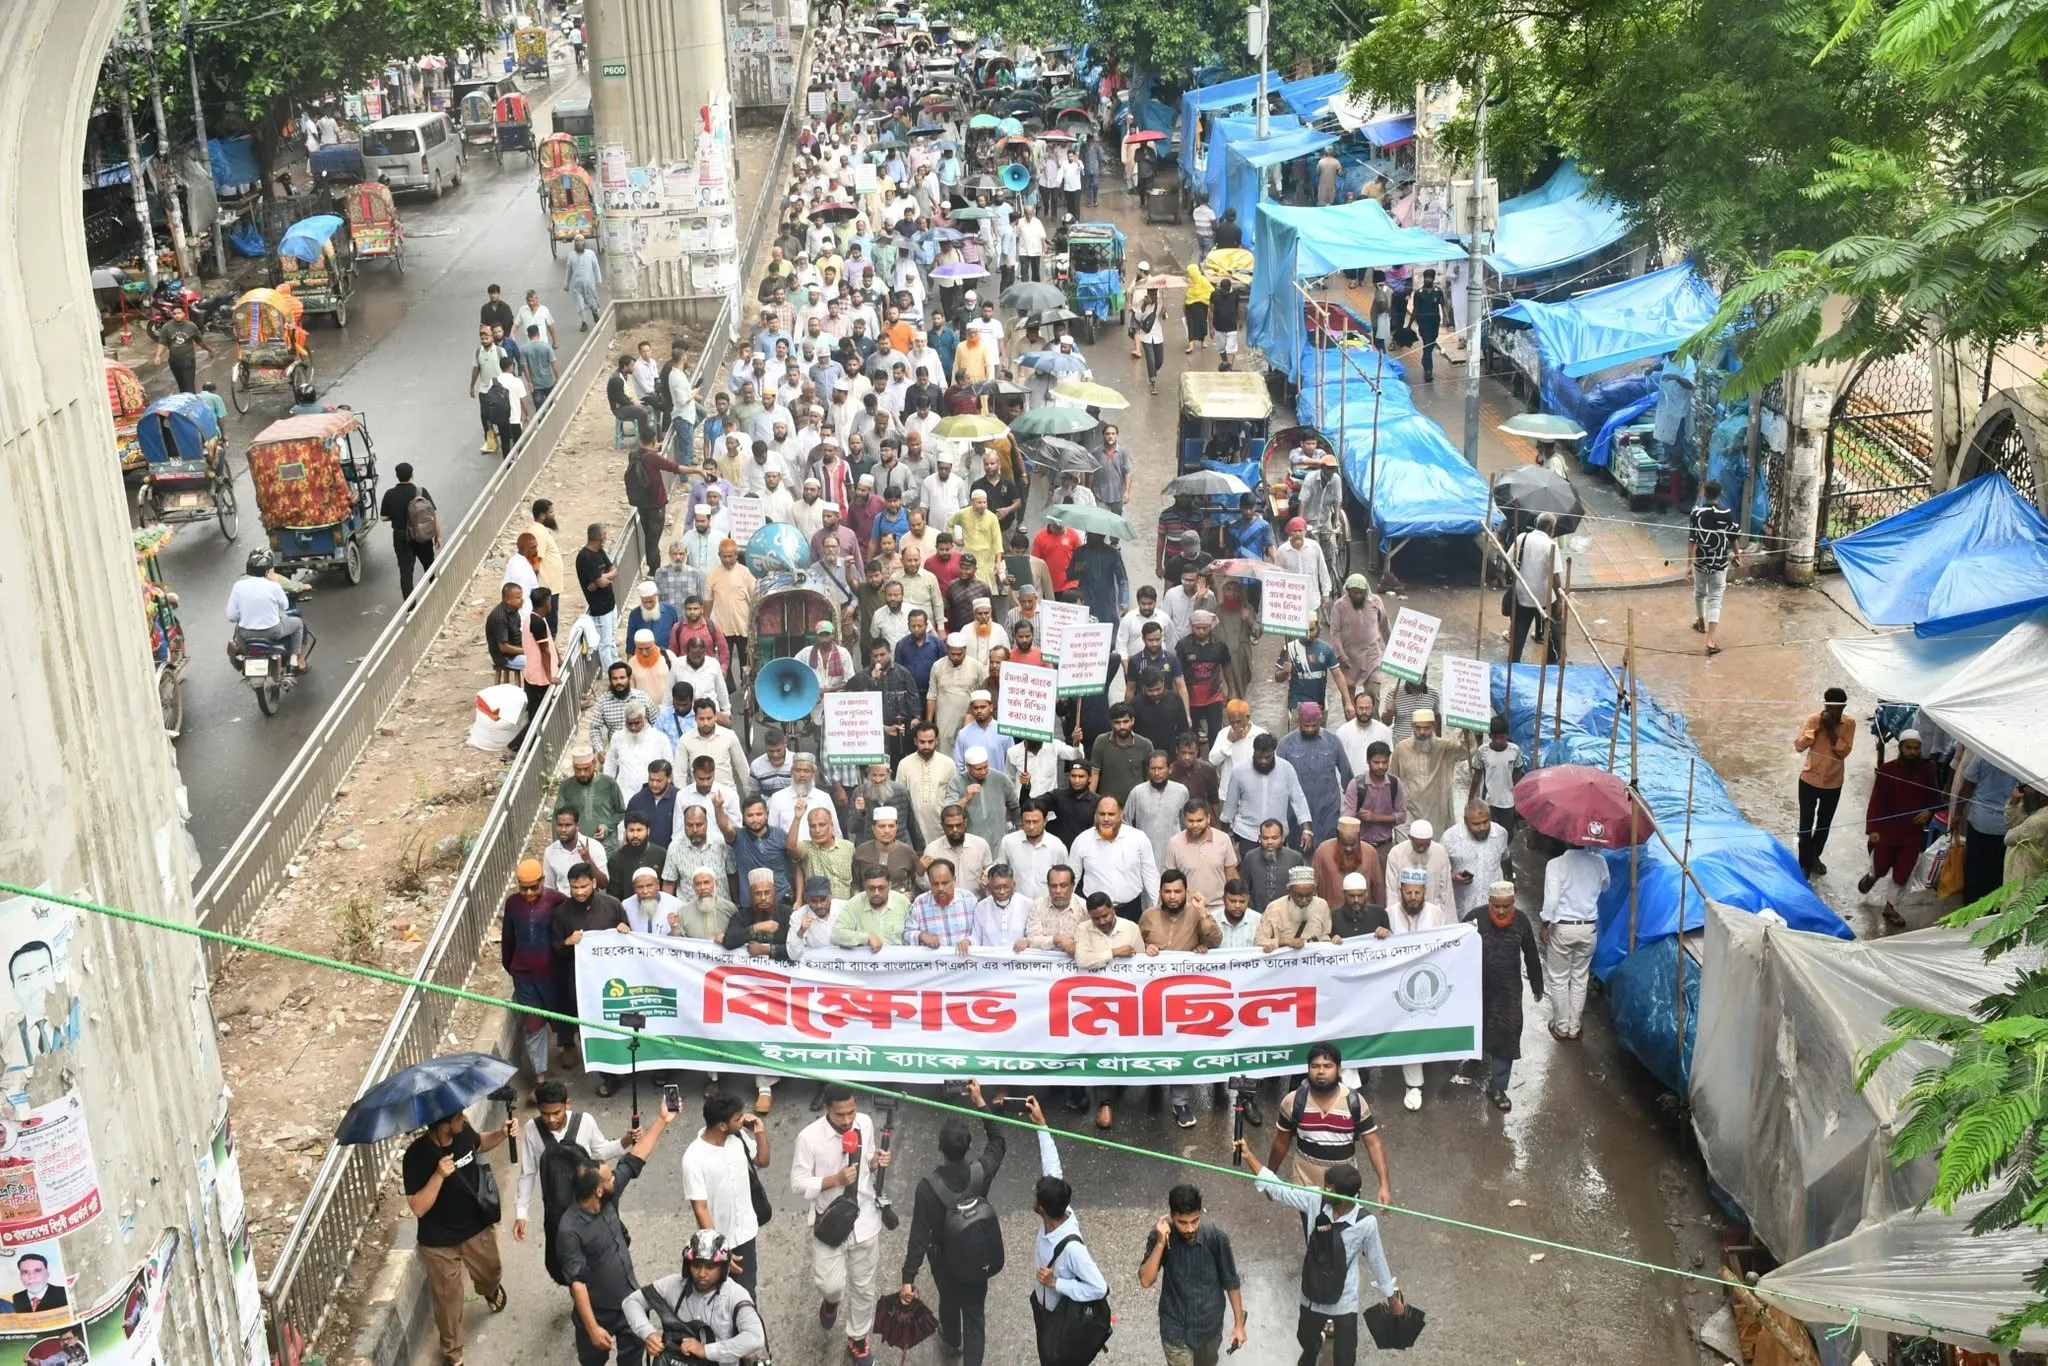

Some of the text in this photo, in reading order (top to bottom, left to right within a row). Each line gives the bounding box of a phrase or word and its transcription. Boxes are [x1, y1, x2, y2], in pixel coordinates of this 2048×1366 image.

[604, 66, 625, 75] P600
[592, 946, 634, 958] গ্রাহকের
[806, 958, 845, 972] ইসলামী
[850, 960, 879, 972] ব্যাংক
[884, 960, 932, 972] বাংলাদেশ
[935, 959, 977, 972] পিএলসি
[982, 961, 998, 971] এর
[1002, 959, 1052, 972] পরিচালনা
[1112, 962, 1133, 973] এবং
[1137, 961, 1166, 976] প্রকৃত
[1171, 960, 1226, 973] মালিকদের
[1230, 959, 1260, 970] নিকট
[1264, 957, 1298, 968] তাদের
[1302, 953, 1349, 966] মালিকানা
[610, 979, 624, 997] ৯
[703, 965, 1317, 1039] বিক্ষোভ মিছিল
[760, 1043, 1294, 1072] ইসলামী ব্যাংক সচেতন গ্রাহক ফোরাম
